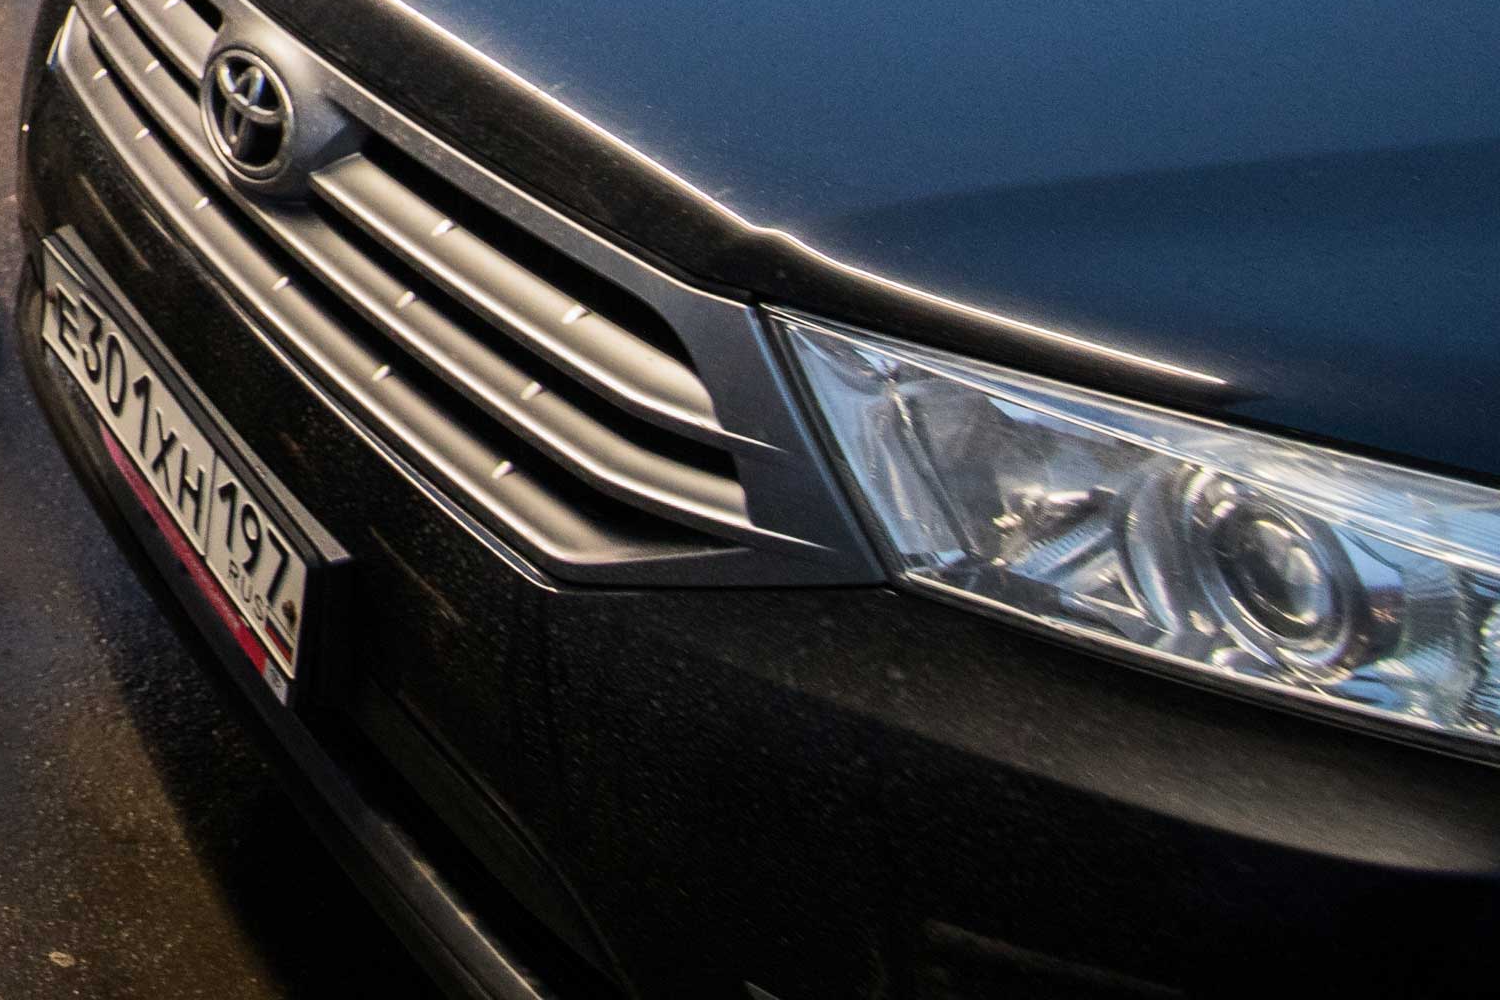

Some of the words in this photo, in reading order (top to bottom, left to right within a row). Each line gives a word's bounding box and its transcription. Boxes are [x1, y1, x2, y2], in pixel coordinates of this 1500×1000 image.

[55, 283, 206, 536] Е301ХН
[218, 480, 291, 604] 197
[227, 559, 265, 622] RUS
